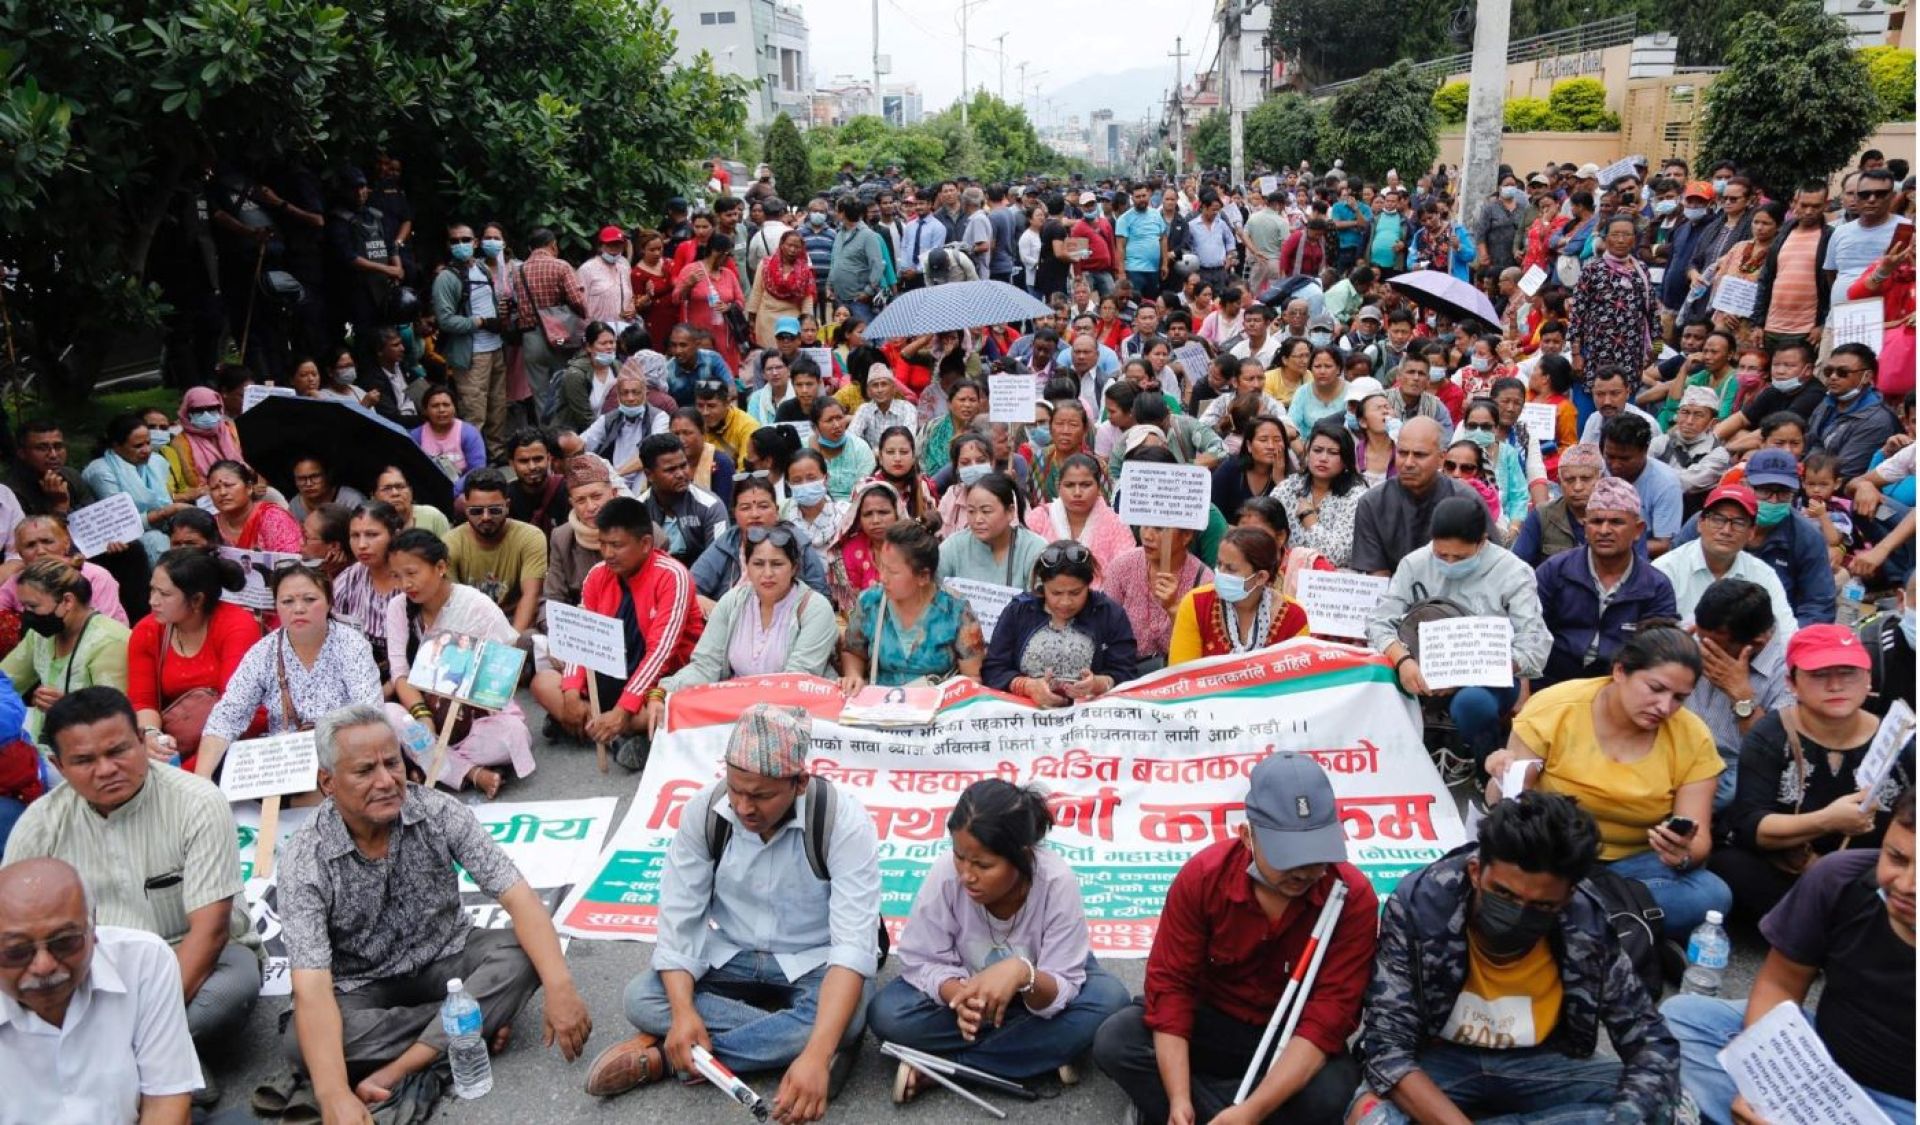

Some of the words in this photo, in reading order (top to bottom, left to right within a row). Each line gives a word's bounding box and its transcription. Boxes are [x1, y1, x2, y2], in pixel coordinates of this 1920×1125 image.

[971, 712, 1025, 732] सहकारी
[933, 738, 991, 756] अविलम्ब
[1000, 735, 1036, 752] फिर्ता
[1164, 726, 1201, 744] लागी
[1029, 748, 1123, 783] पिडित
